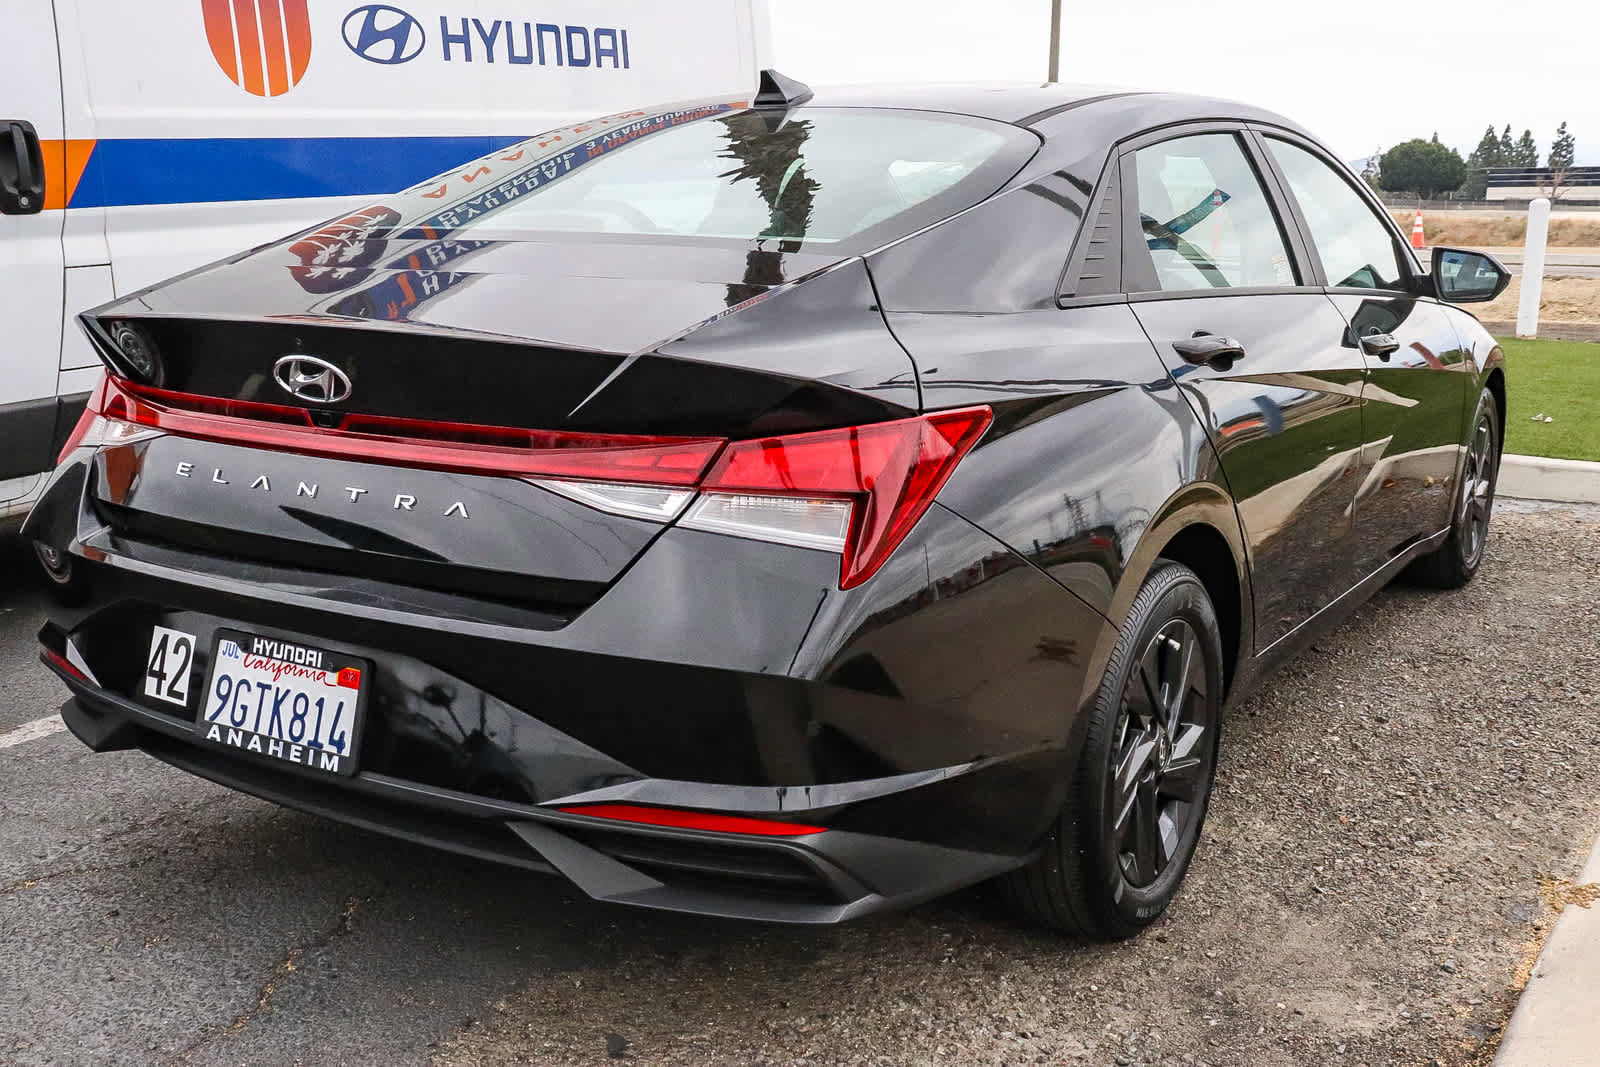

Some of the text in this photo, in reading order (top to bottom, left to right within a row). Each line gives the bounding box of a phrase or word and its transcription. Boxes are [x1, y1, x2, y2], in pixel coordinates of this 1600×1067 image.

[440, 15, 630, 69] HYUNDAI
[175, 461, 470, 520] ELANTRA
[148, 633, 192, 701] 42
[222, 642, 240, 659] JUL
[243, 653, 336, 687] California
[253, 638, 322, 668] HYUNDAI
[209, 674, 346, 754] 9GTK814
[206, 724, 340, 773] ANAHEIM
